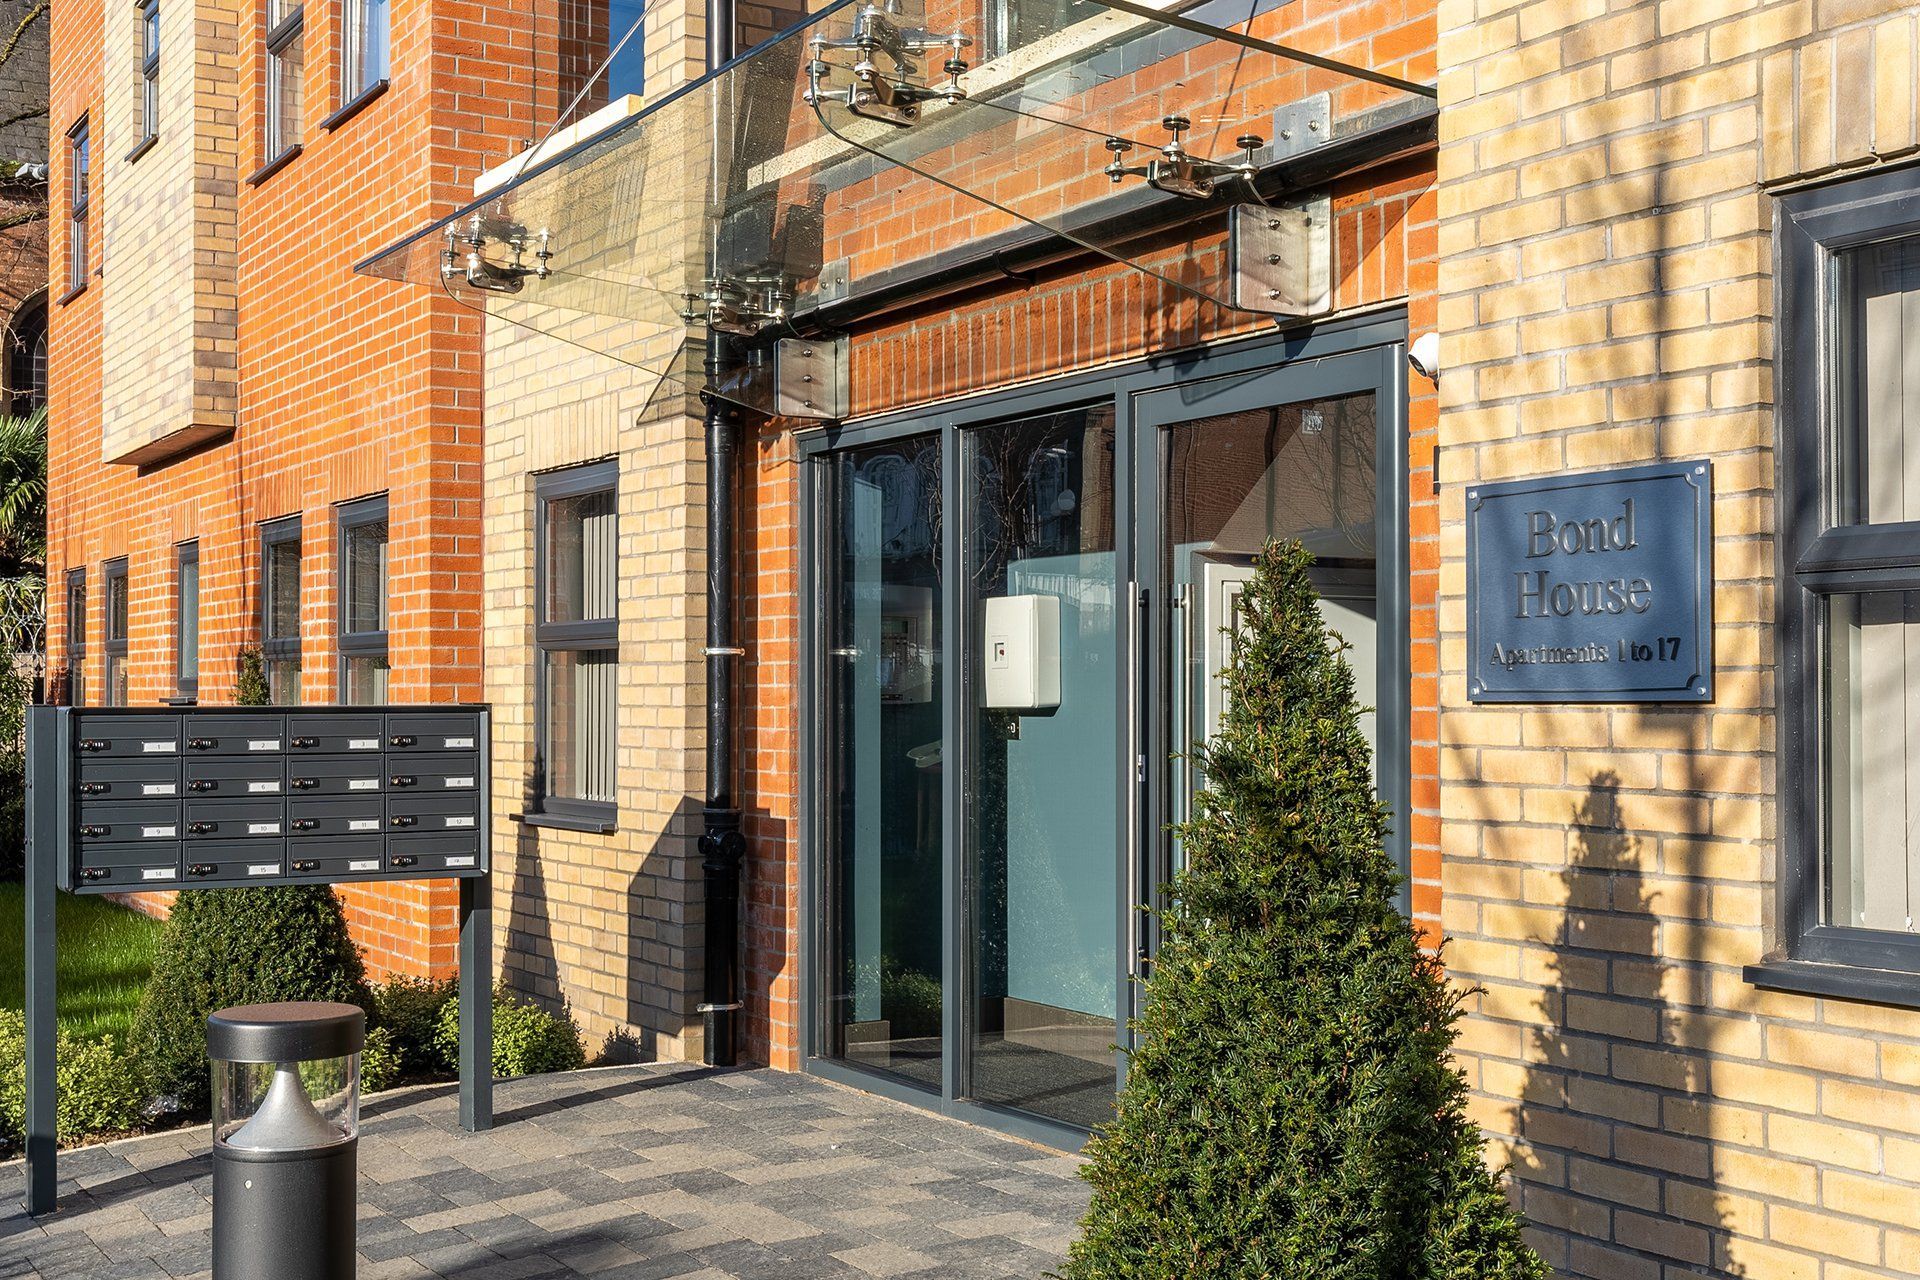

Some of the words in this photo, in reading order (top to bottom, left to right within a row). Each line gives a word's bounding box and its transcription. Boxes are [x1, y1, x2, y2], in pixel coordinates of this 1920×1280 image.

[1524, 497, 1639, 559] Bond
[1514, 570, 1652, 619] House
[1490, 641, 1610, 671] Apartments
[1617, 638, 1627, 662] 1
[1631, 640, 1654, 662] to
[1657, 637, 1682, 662] 17
